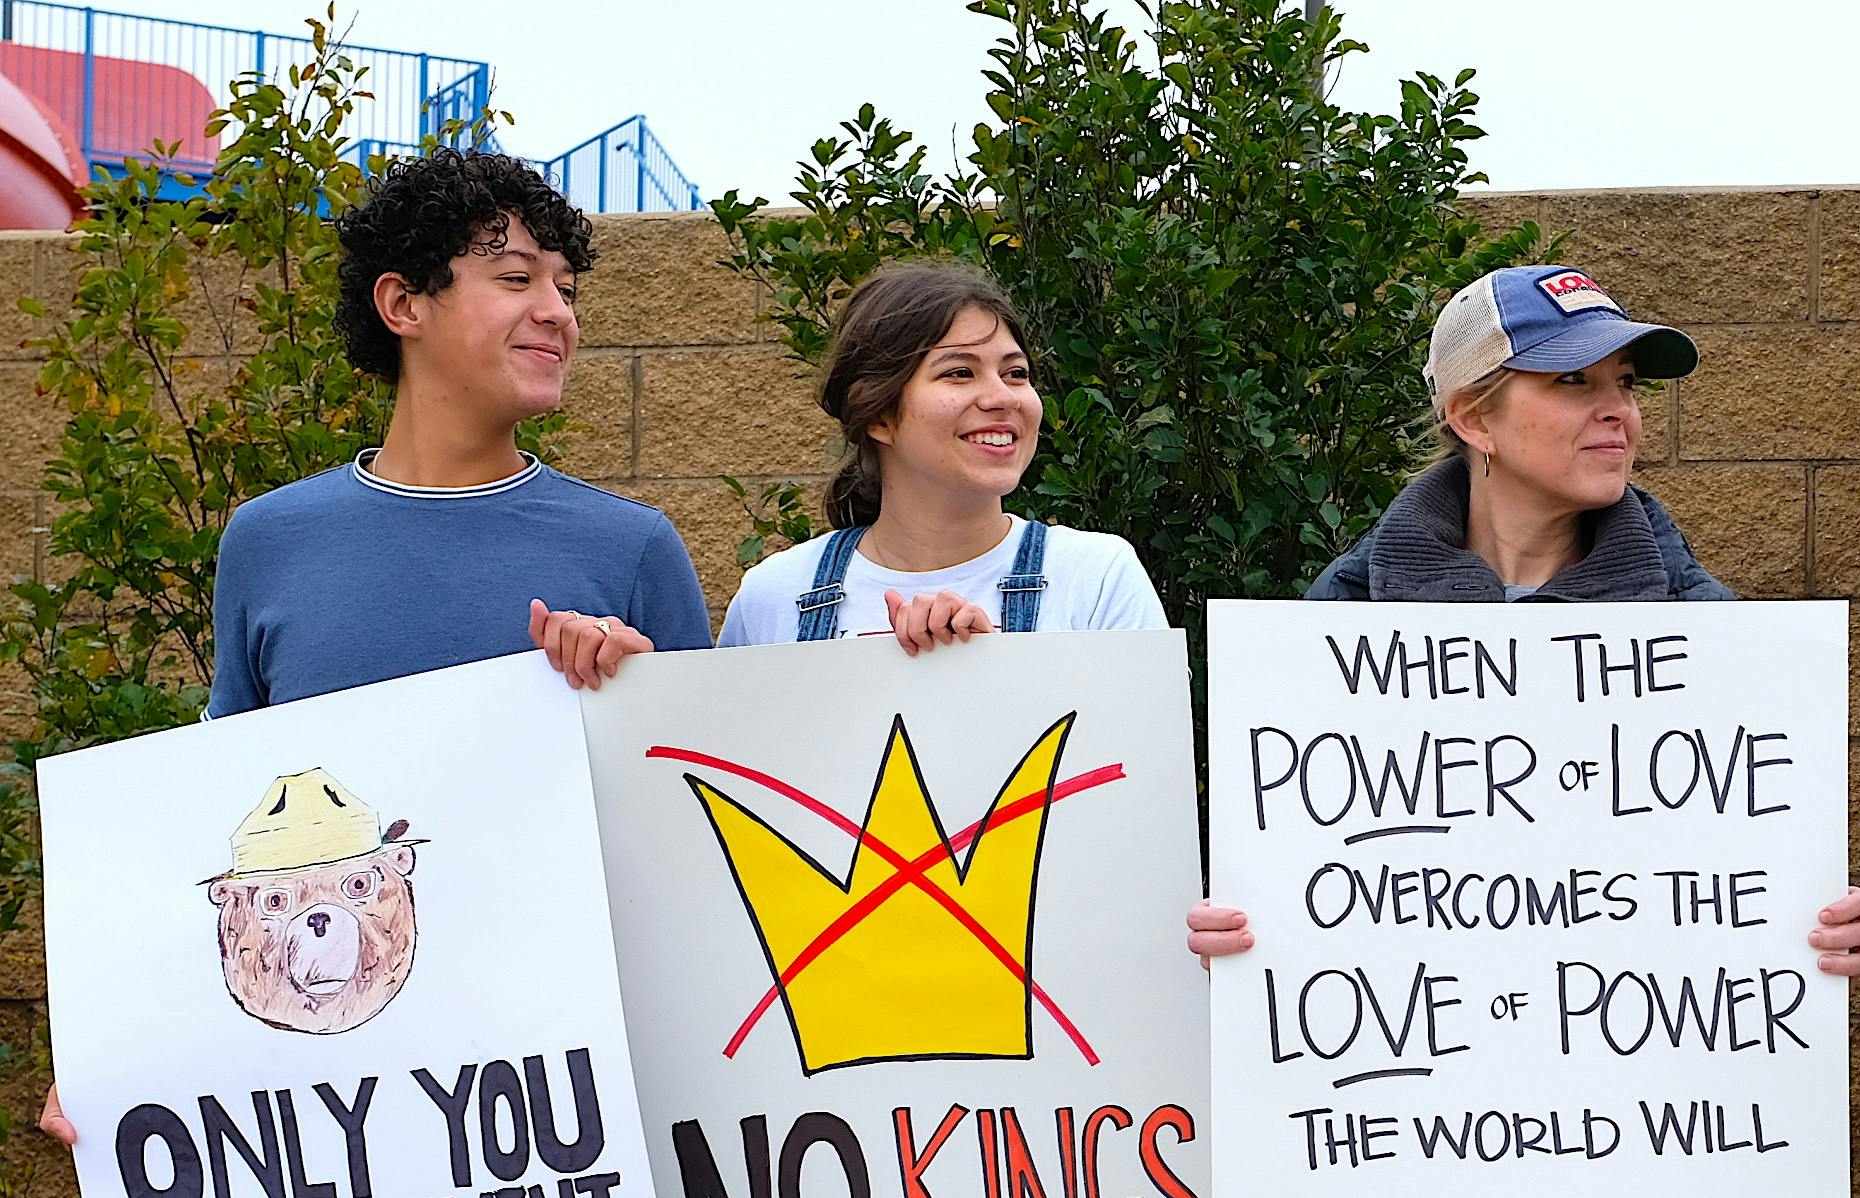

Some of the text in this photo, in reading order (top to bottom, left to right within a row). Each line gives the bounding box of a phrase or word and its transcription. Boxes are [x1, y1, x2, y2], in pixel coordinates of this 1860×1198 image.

[1325, 630, 1688, 702] WHEN THE
[1250, 724, 1793, 830] POWER OF LOVE
[1306, 863, 1767, 930] OVERCOMES THE
[1265, 961, 1809, 1063] LOVE OF POWER
[410, 1048, 605, 1188] YOU
[1289, 1100, 1789, 1170] THE WORLD WILL
